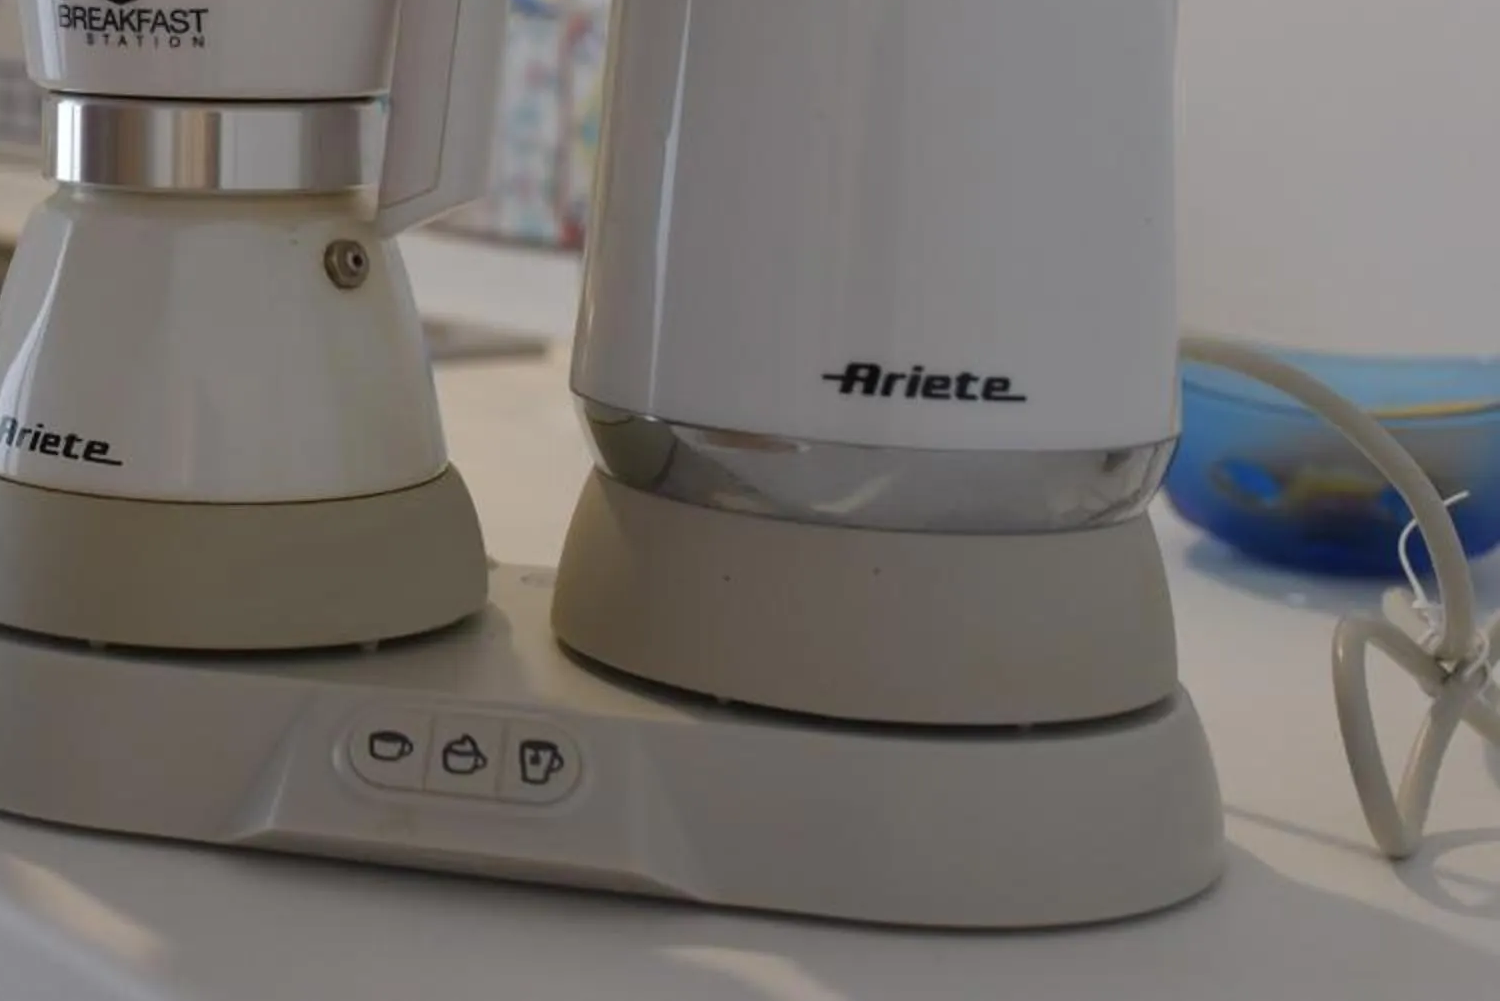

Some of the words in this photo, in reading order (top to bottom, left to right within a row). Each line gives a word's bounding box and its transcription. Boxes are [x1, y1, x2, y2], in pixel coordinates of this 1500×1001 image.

[57, 4, 209, 34] BREAKFAST
[86, 33, 206, 48] STATION
[820, 361, 1028, 403] Ariete
